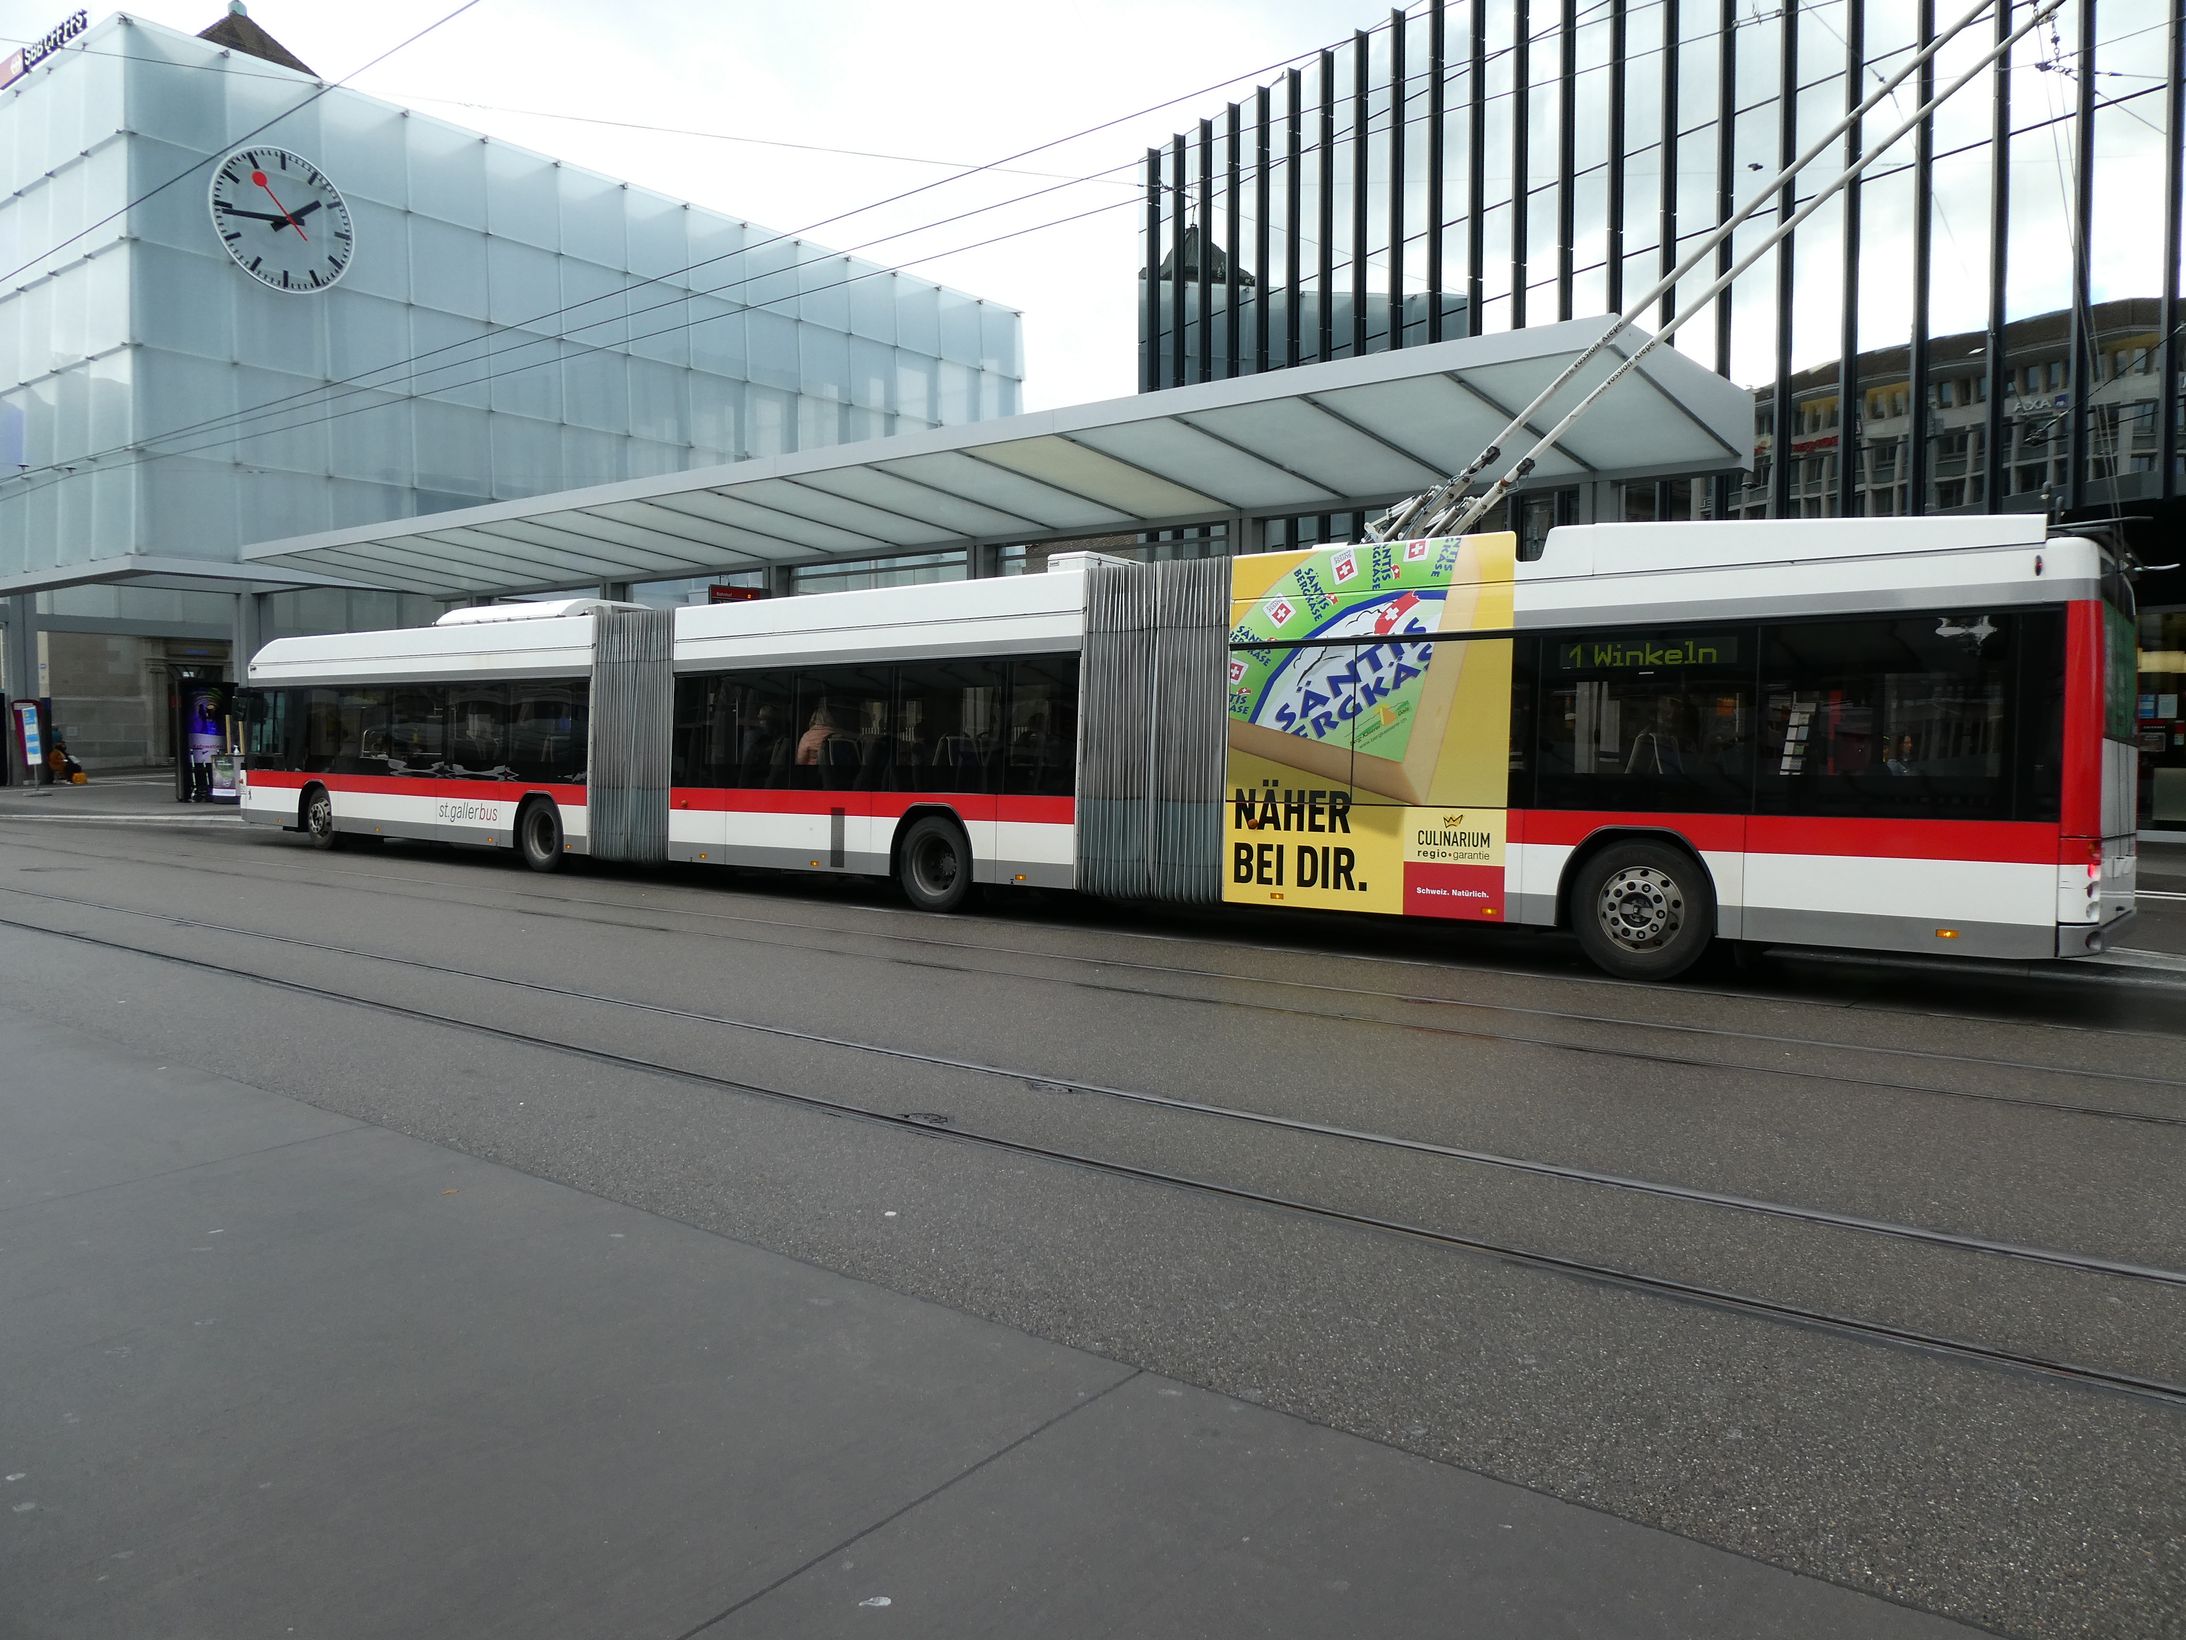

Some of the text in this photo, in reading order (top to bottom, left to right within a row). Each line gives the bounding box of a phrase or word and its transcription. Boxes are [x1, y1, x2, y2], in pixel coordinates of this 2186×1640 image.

[24, 41, 43, 66] SBB
[1304, 568, 1330, 611] SÄNTIS
[1568, 640, 1718, 668] 1 Winkeln
[438, 802, 498, 822] st.gallerbus
[1235, 779, 1351, 833] NÄHER
[1417, 830, 1490, 848] CULINARIUM
[1234, 842, 1367, 891] BEI DIR.
[1416, 886, 1489, 898] Schweiz. Natürlich.
